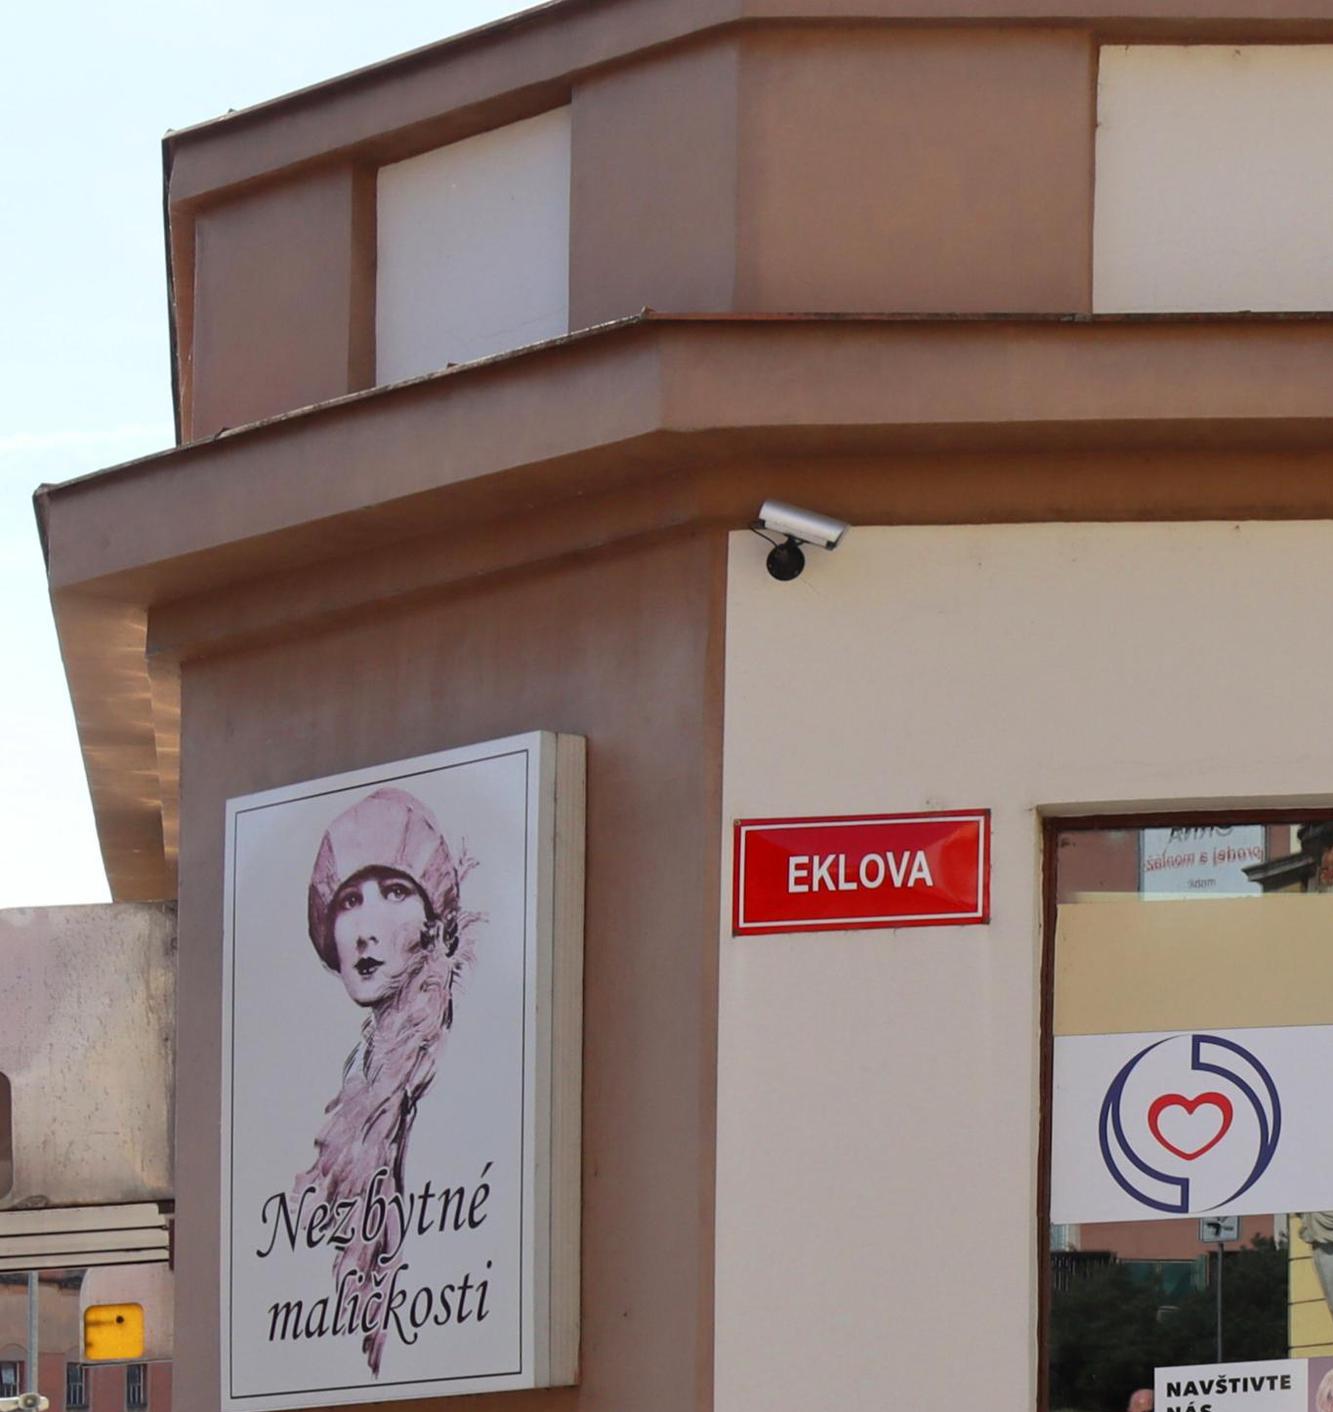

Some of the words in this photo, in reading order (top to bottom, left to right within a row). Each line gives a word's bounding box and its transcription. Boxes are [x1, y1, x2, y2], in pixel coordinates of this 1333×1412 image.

[788, 850, 933, 893] EKLOVA
[256, 1162, 495, 1264] Nezbytné
[267, 1261, 491, 1345] maličkosti
[1166, 1374, 1291, 1398] NAVŠTIVTE
